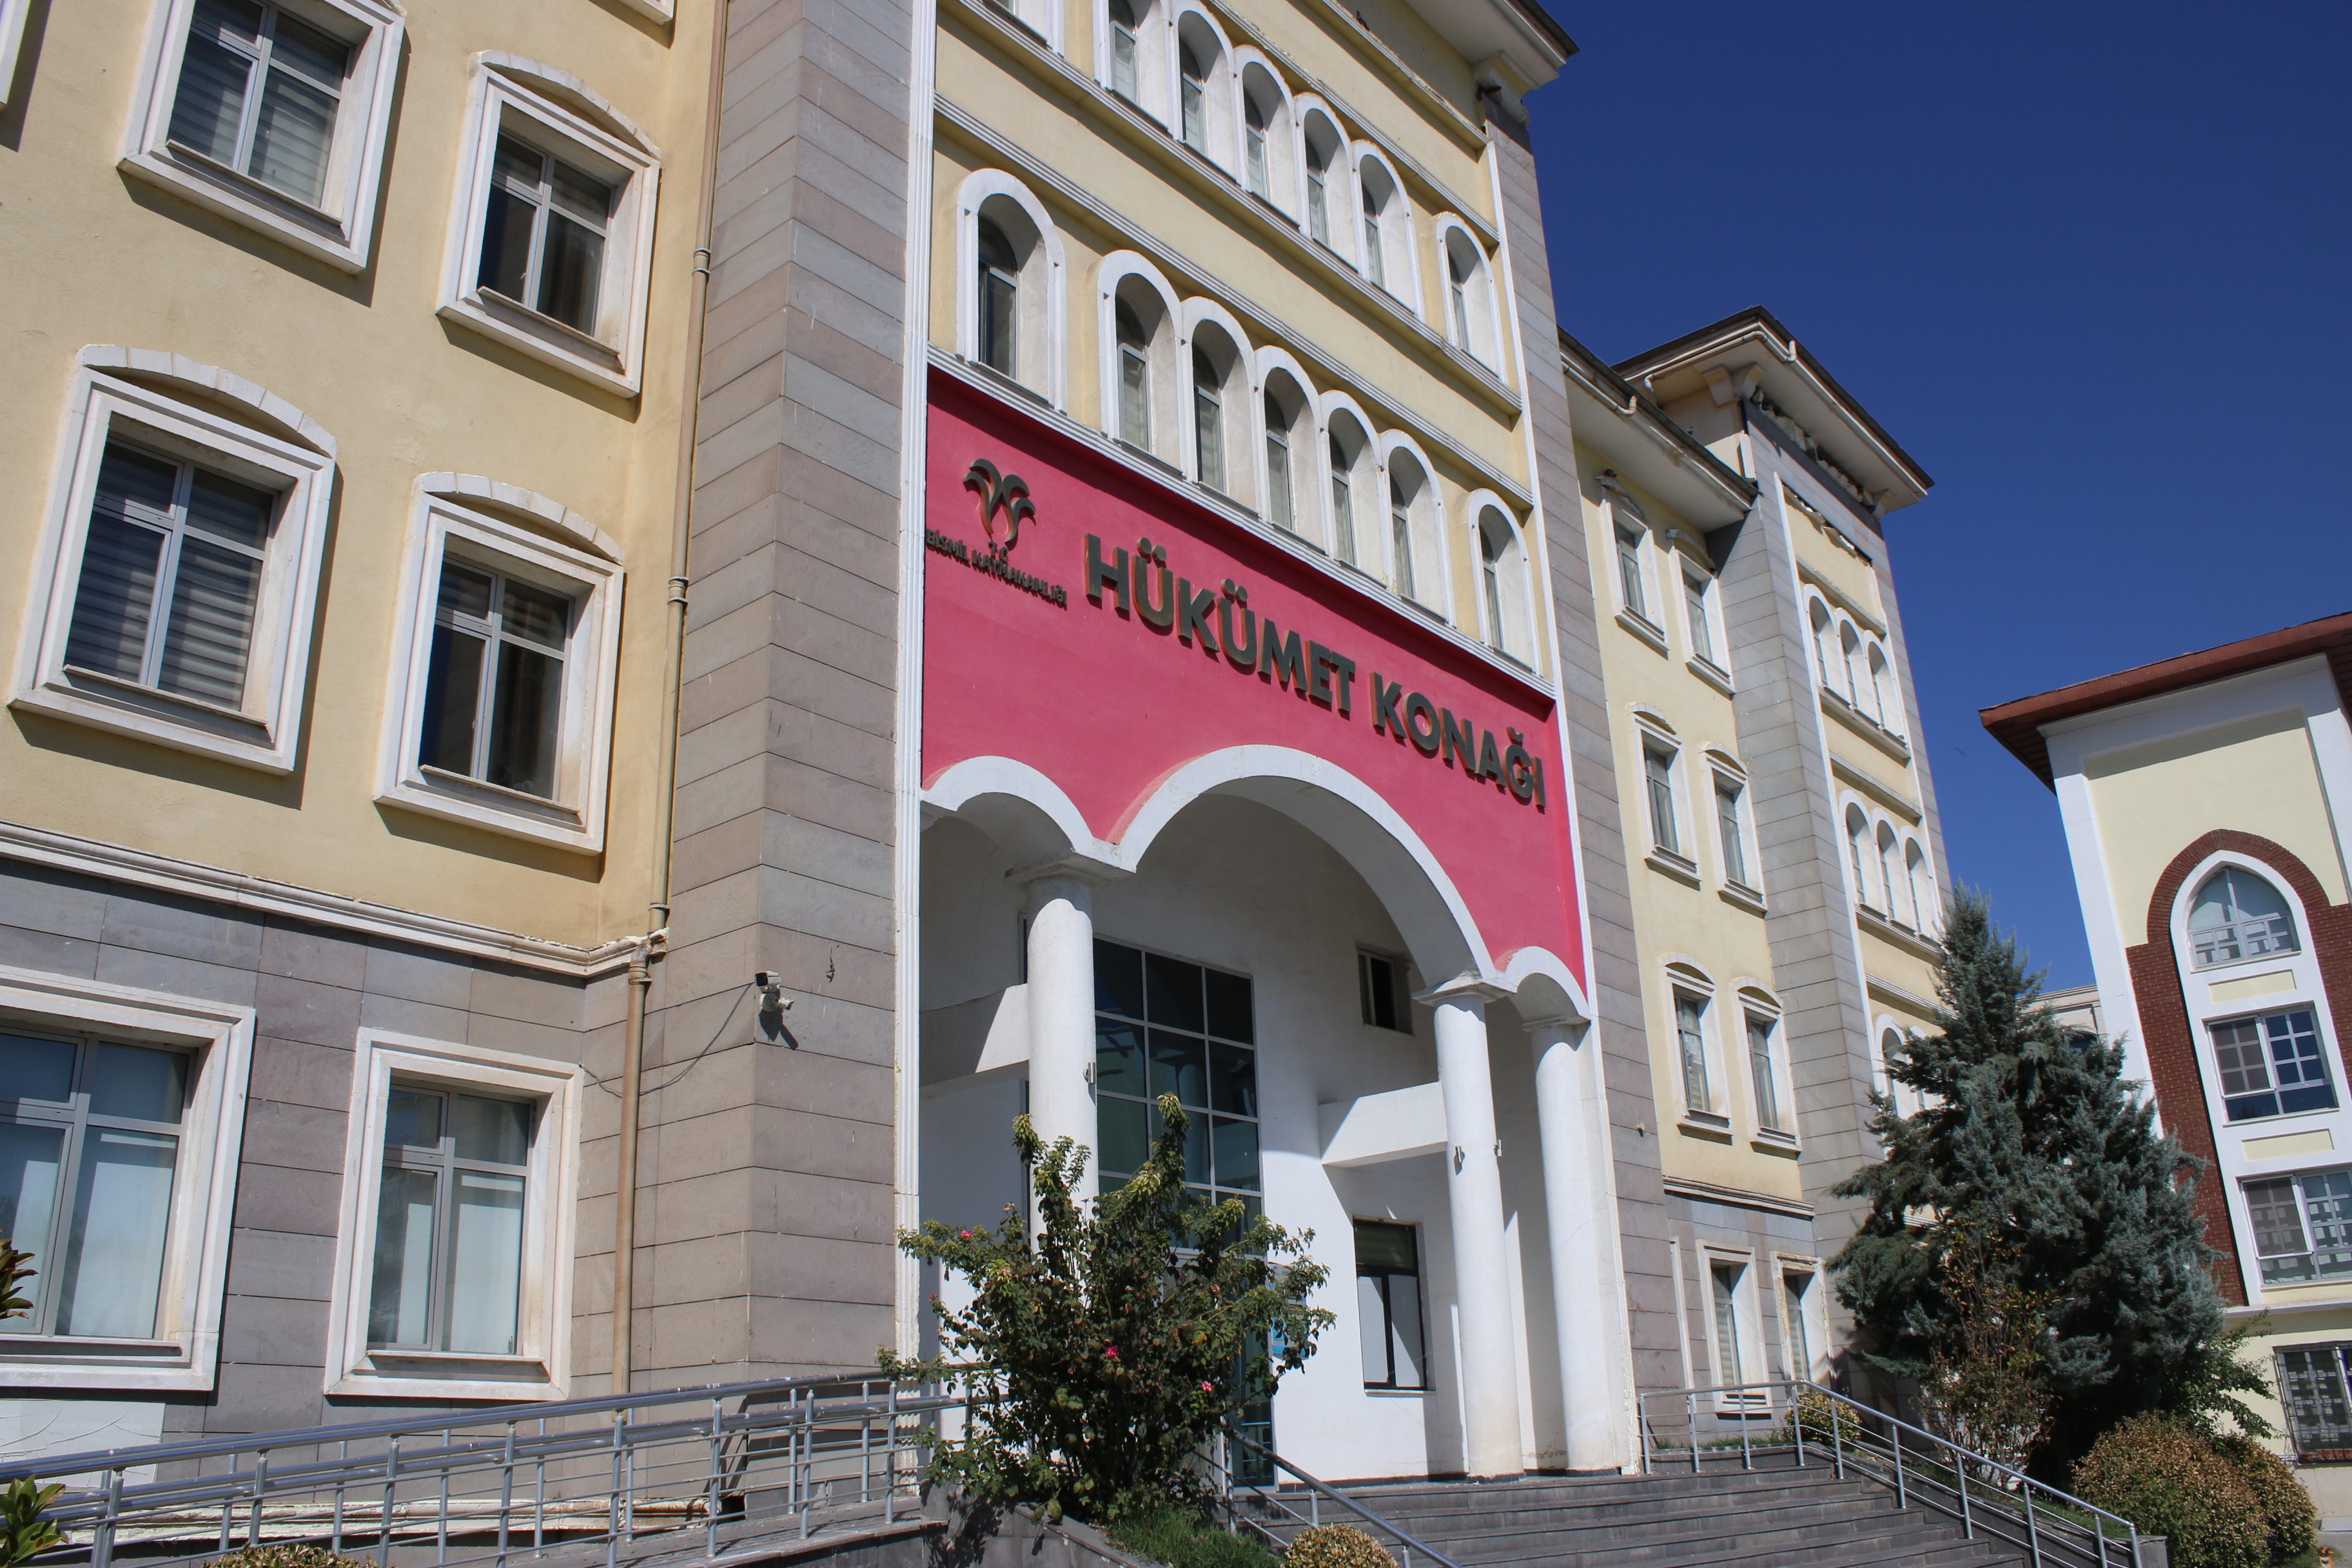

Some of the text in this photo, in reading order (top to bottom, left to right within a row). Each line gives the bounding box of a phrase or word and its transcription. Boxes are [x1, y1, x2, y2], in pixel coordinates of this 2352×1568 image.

[926, 528, 1067, 605] BİSMİL KAYMAKAMLIĞI
[1084, 533, 1546, 808] HÜKÜMET KONAĞI
